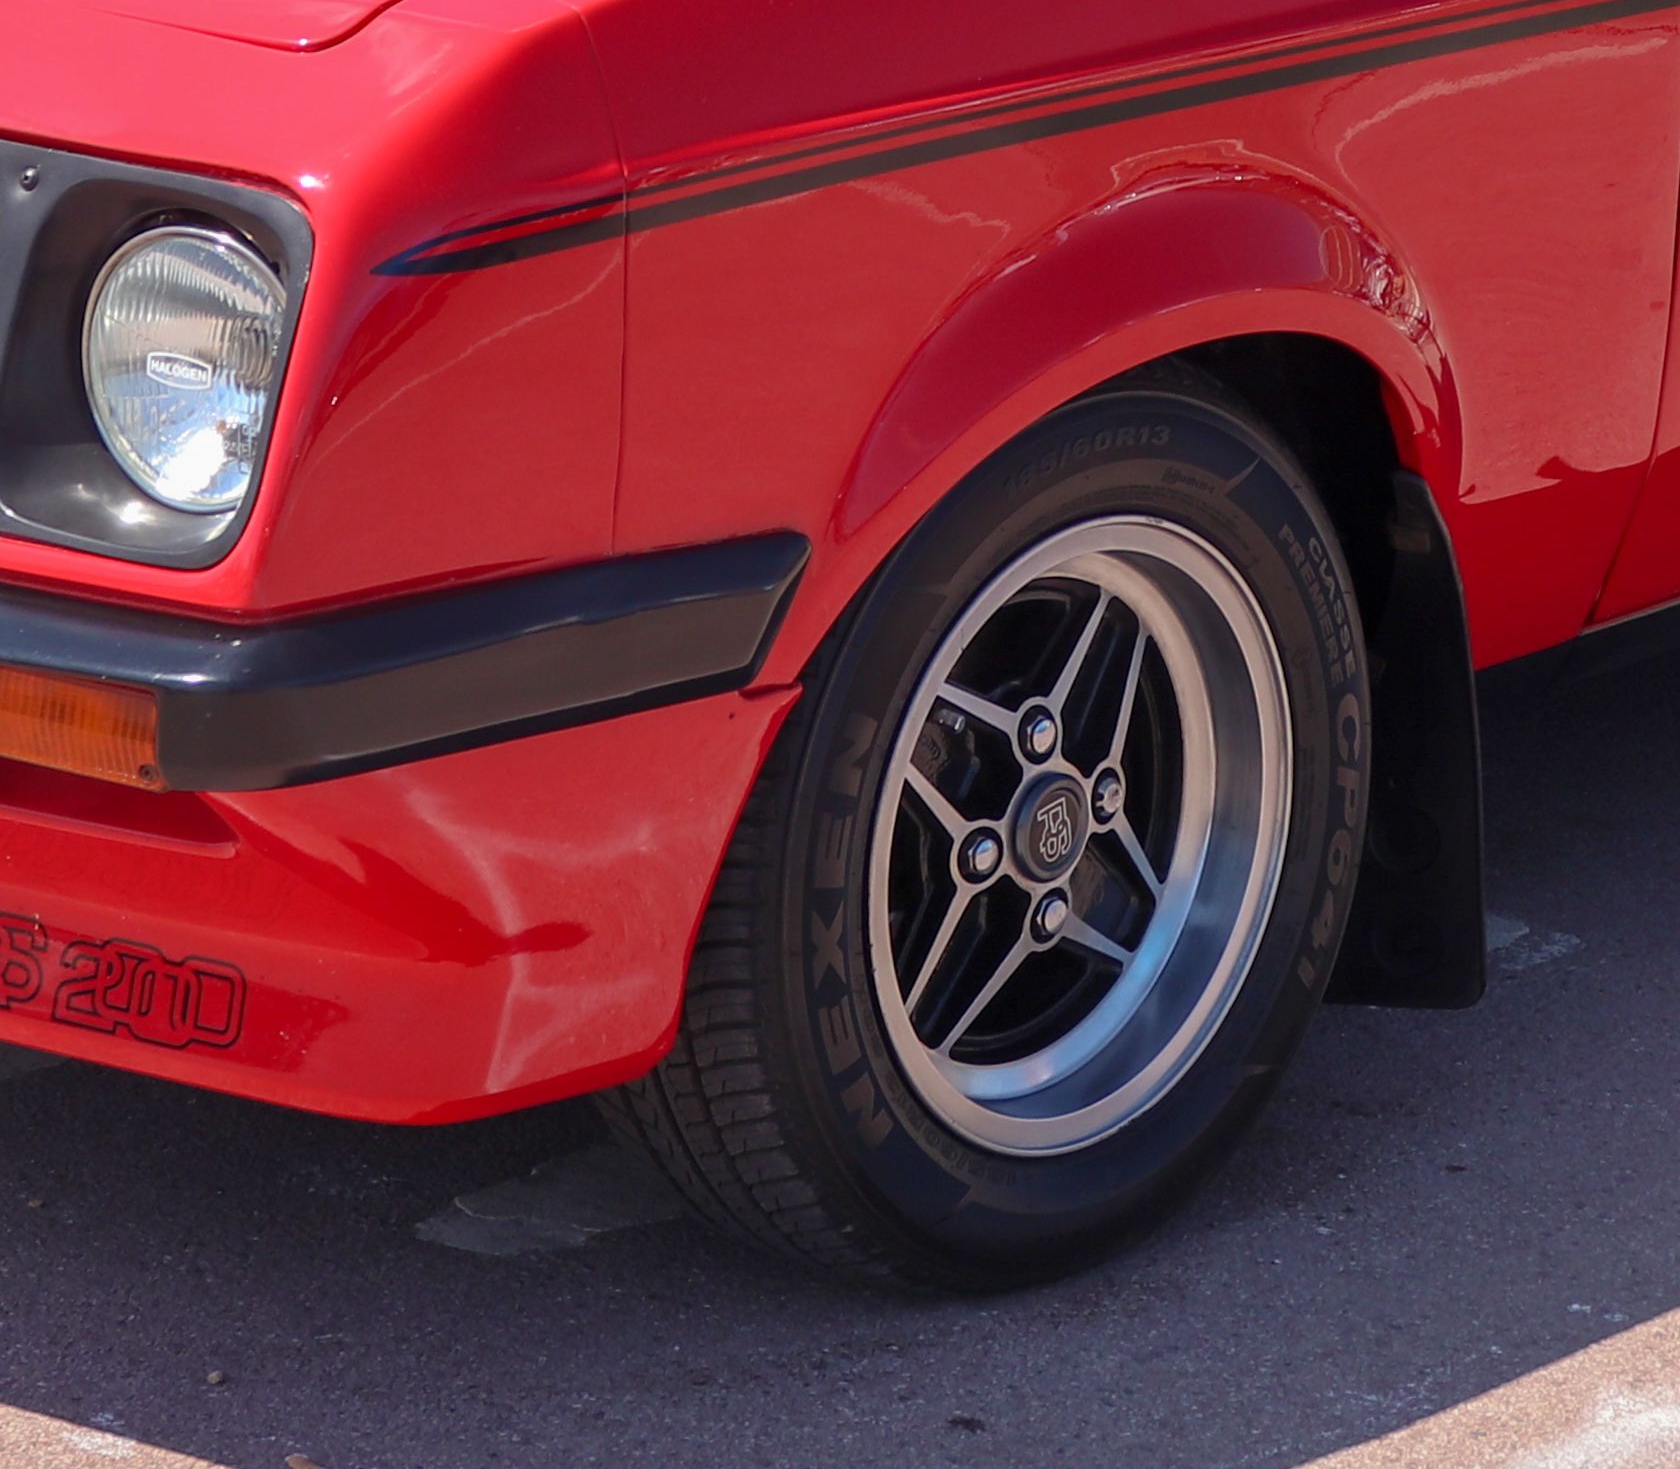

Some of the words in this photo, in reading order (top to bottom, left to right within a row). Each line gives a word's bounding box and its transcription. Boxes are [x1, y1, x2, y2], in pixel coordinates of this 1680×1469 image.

[150, 359, 209, 385] HALOGEN
[1276, 523, 1347, 689] PREMIERE
[1307, 535, 1356, 678] CLASSE
[811, 716, 895, 1152] NEXEN
